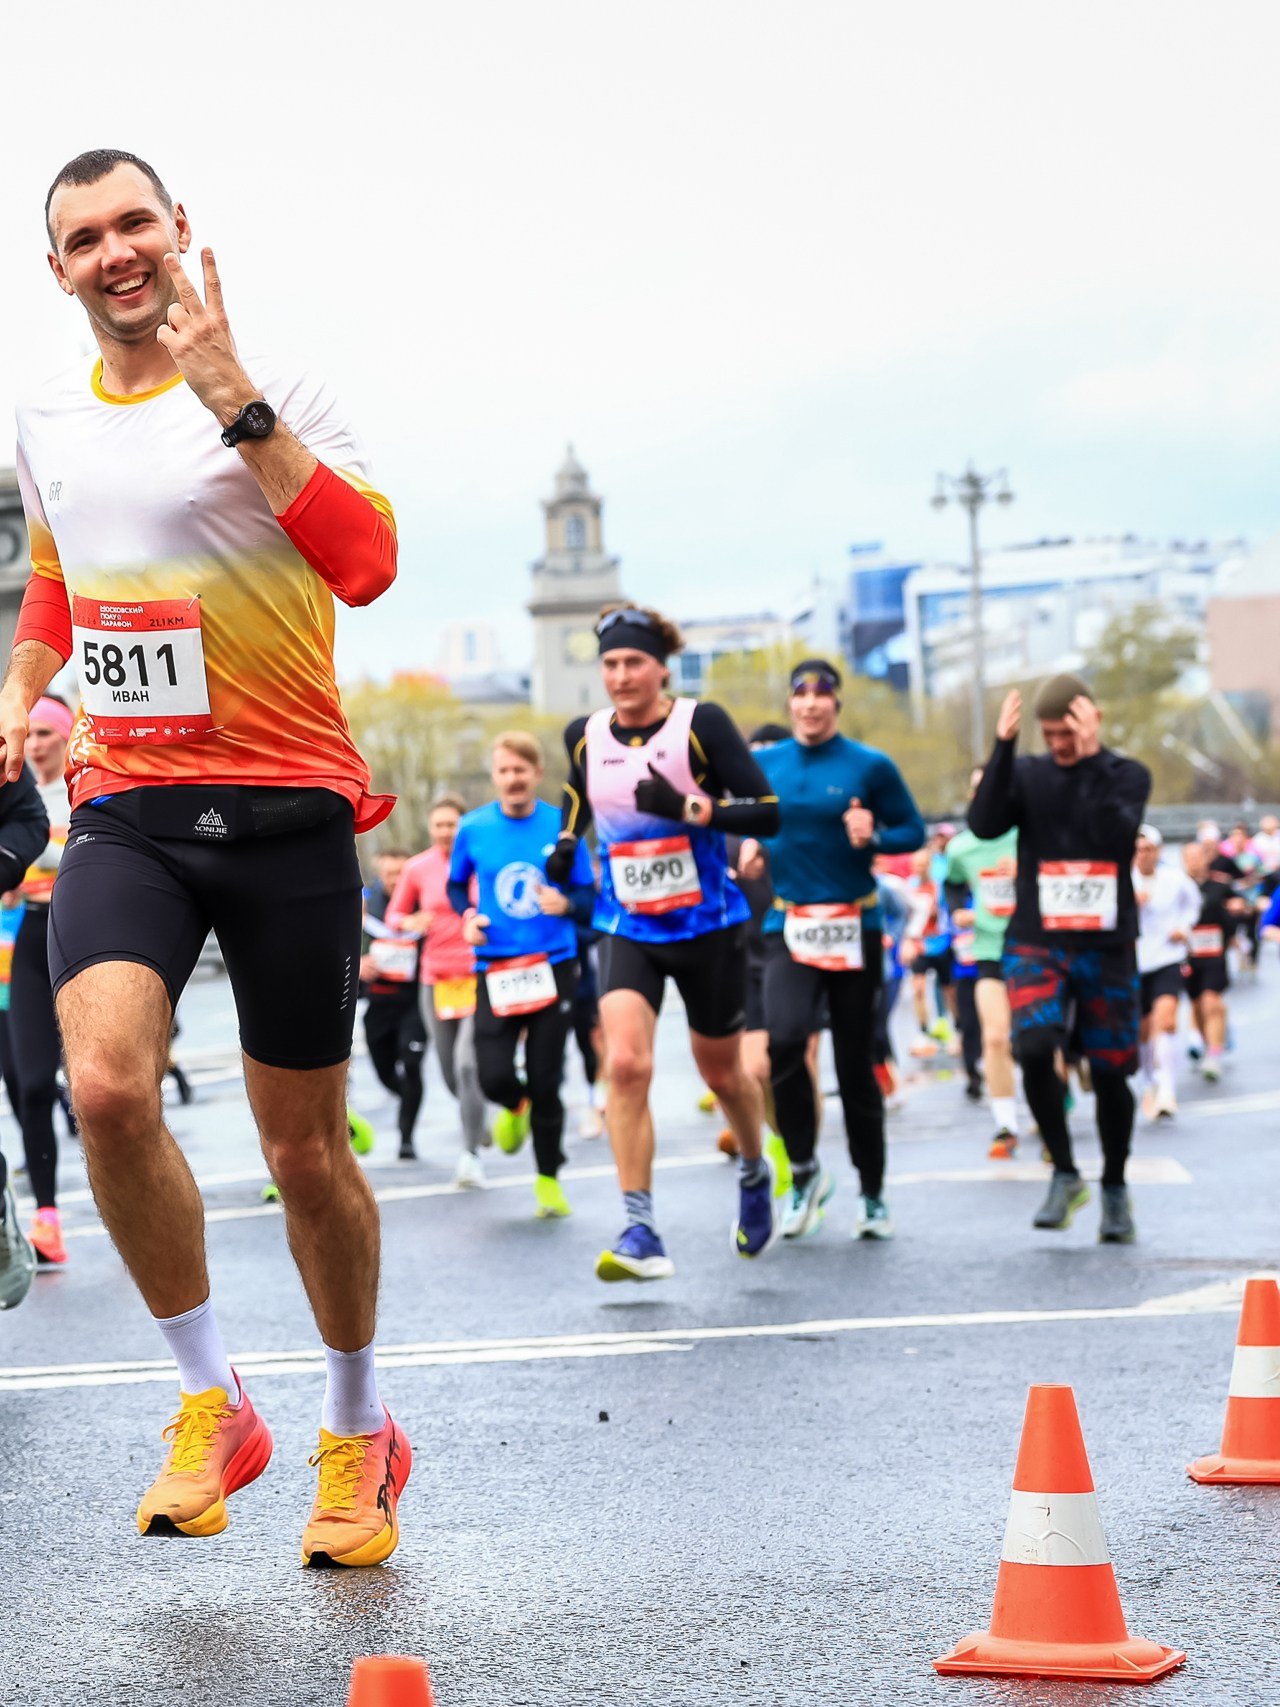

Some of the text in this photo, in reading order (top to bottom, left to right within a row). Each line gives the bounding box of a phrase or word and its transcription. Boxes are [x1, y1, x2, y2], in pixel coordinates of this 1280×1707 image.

[48, 481, 63, 502] GR
[99, 605, 144, 614] МОСКОВСКИЙ
[83, 640, 178, 687] 5811
[112, 690, 150, 703] ИВАН
[624, 857, 684, 886] 8690
